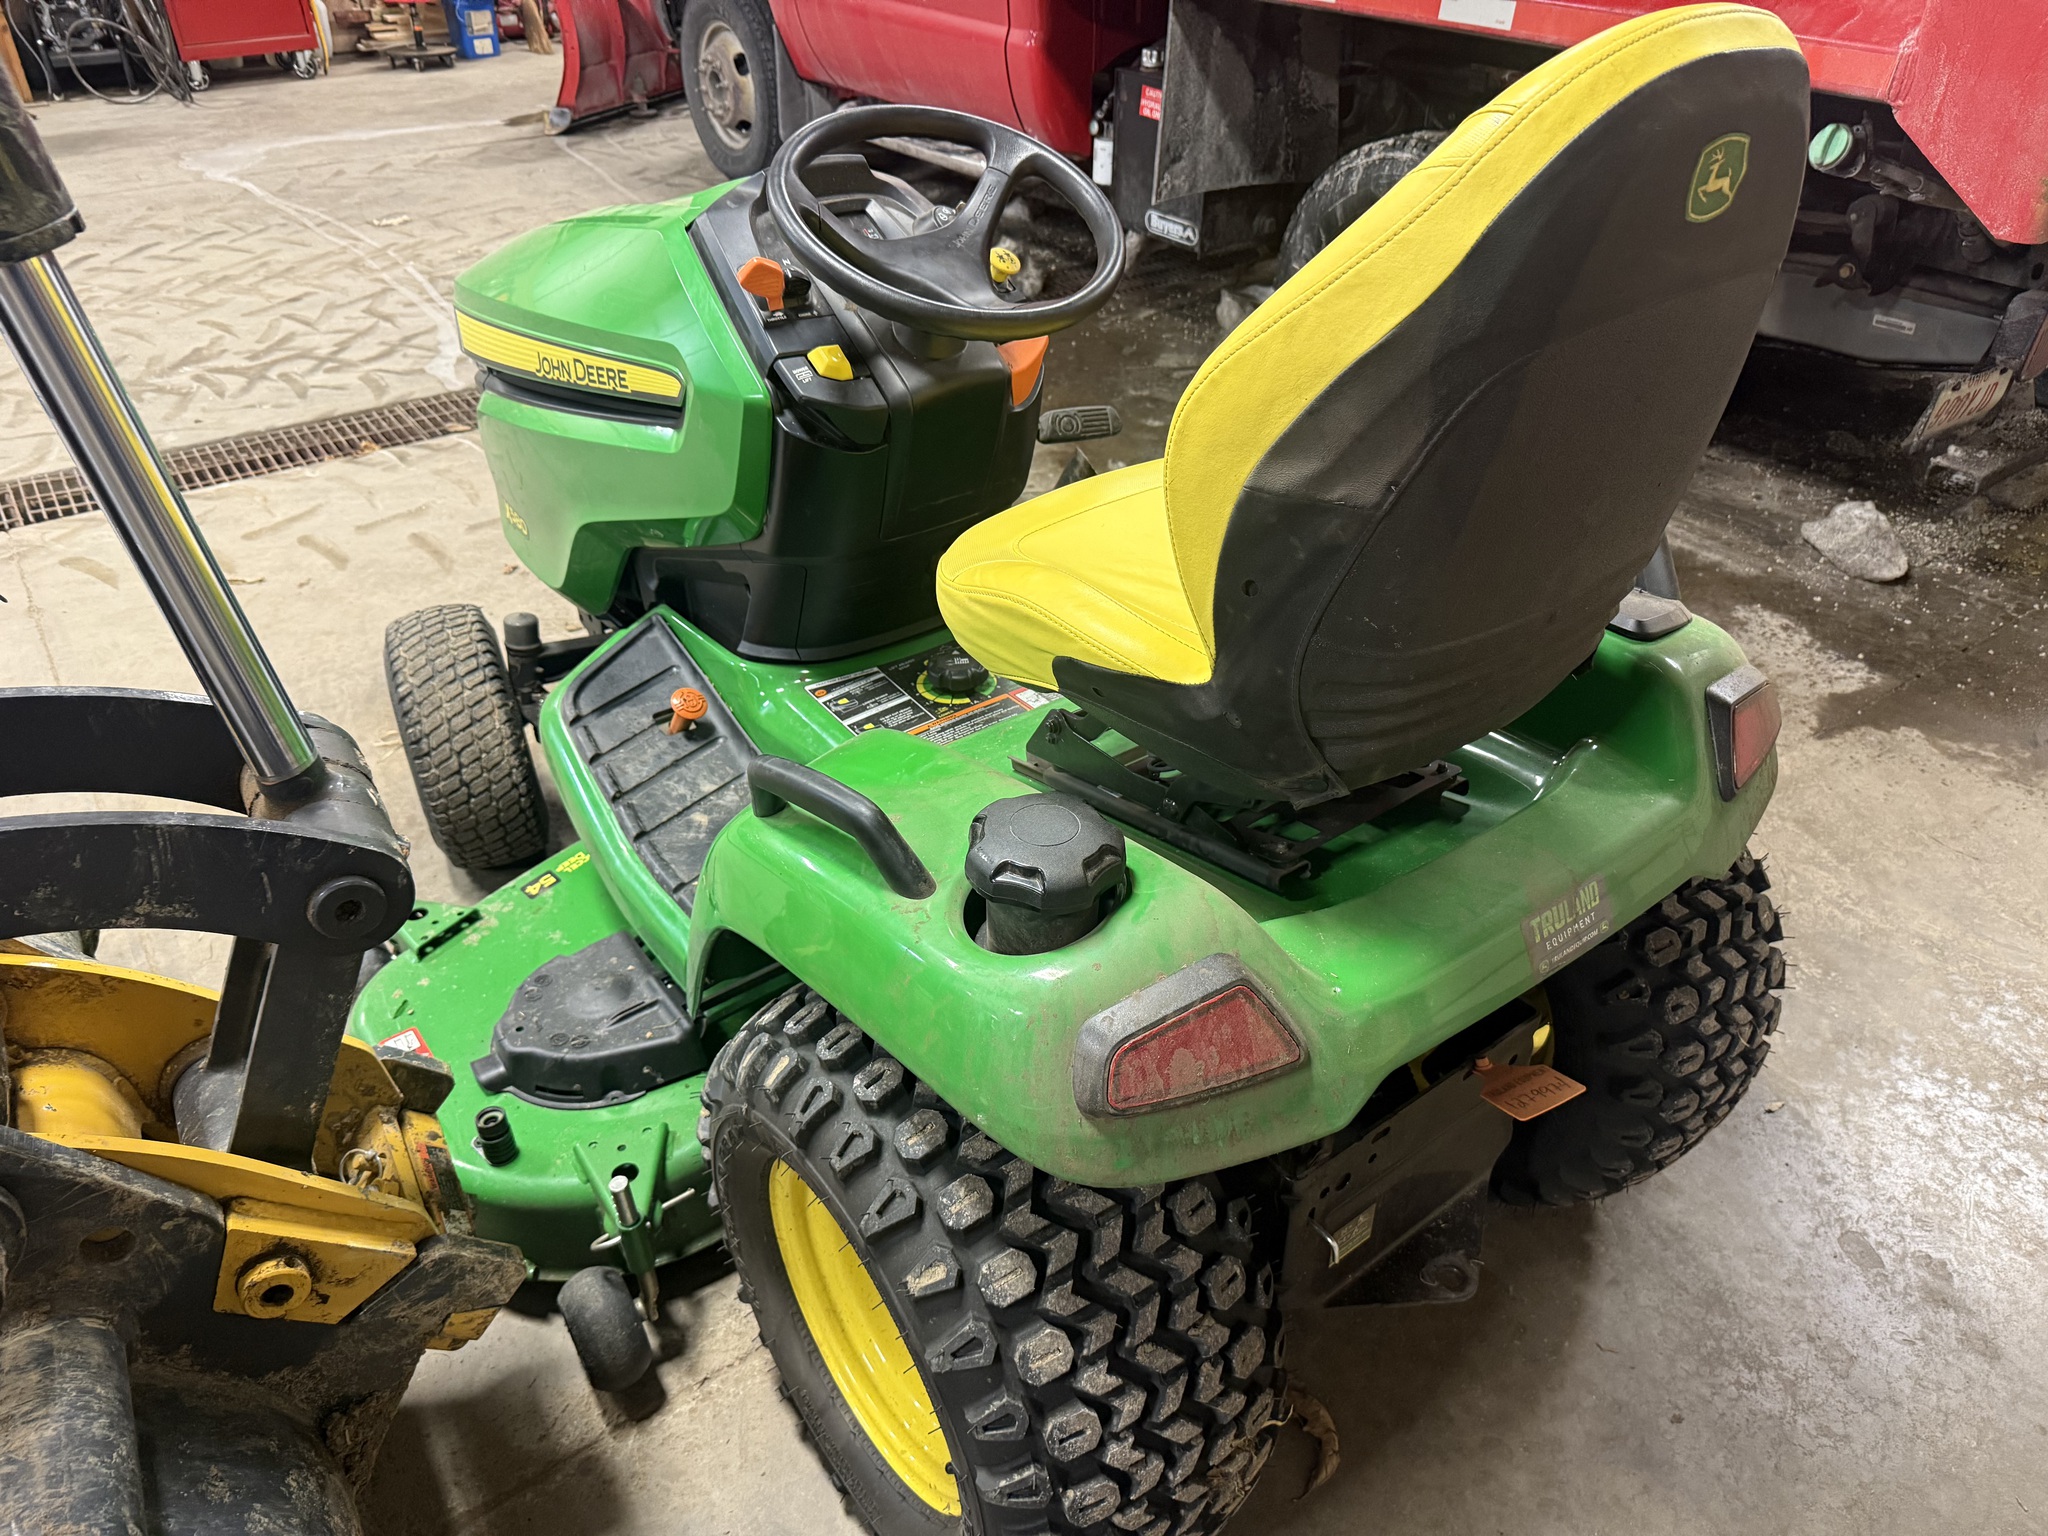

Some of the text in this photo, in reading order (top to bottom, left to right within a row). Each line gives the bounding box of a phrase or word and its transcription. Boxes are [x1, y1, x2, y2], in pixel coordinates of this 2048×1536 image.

[971, 184, 998, 227] DEERE
[1149, 213, 1184, 239] Buyers
[535, 352, 630, 392] JOHN DEERE
[1545, 911, 1597, 951] EQUIPMENT
